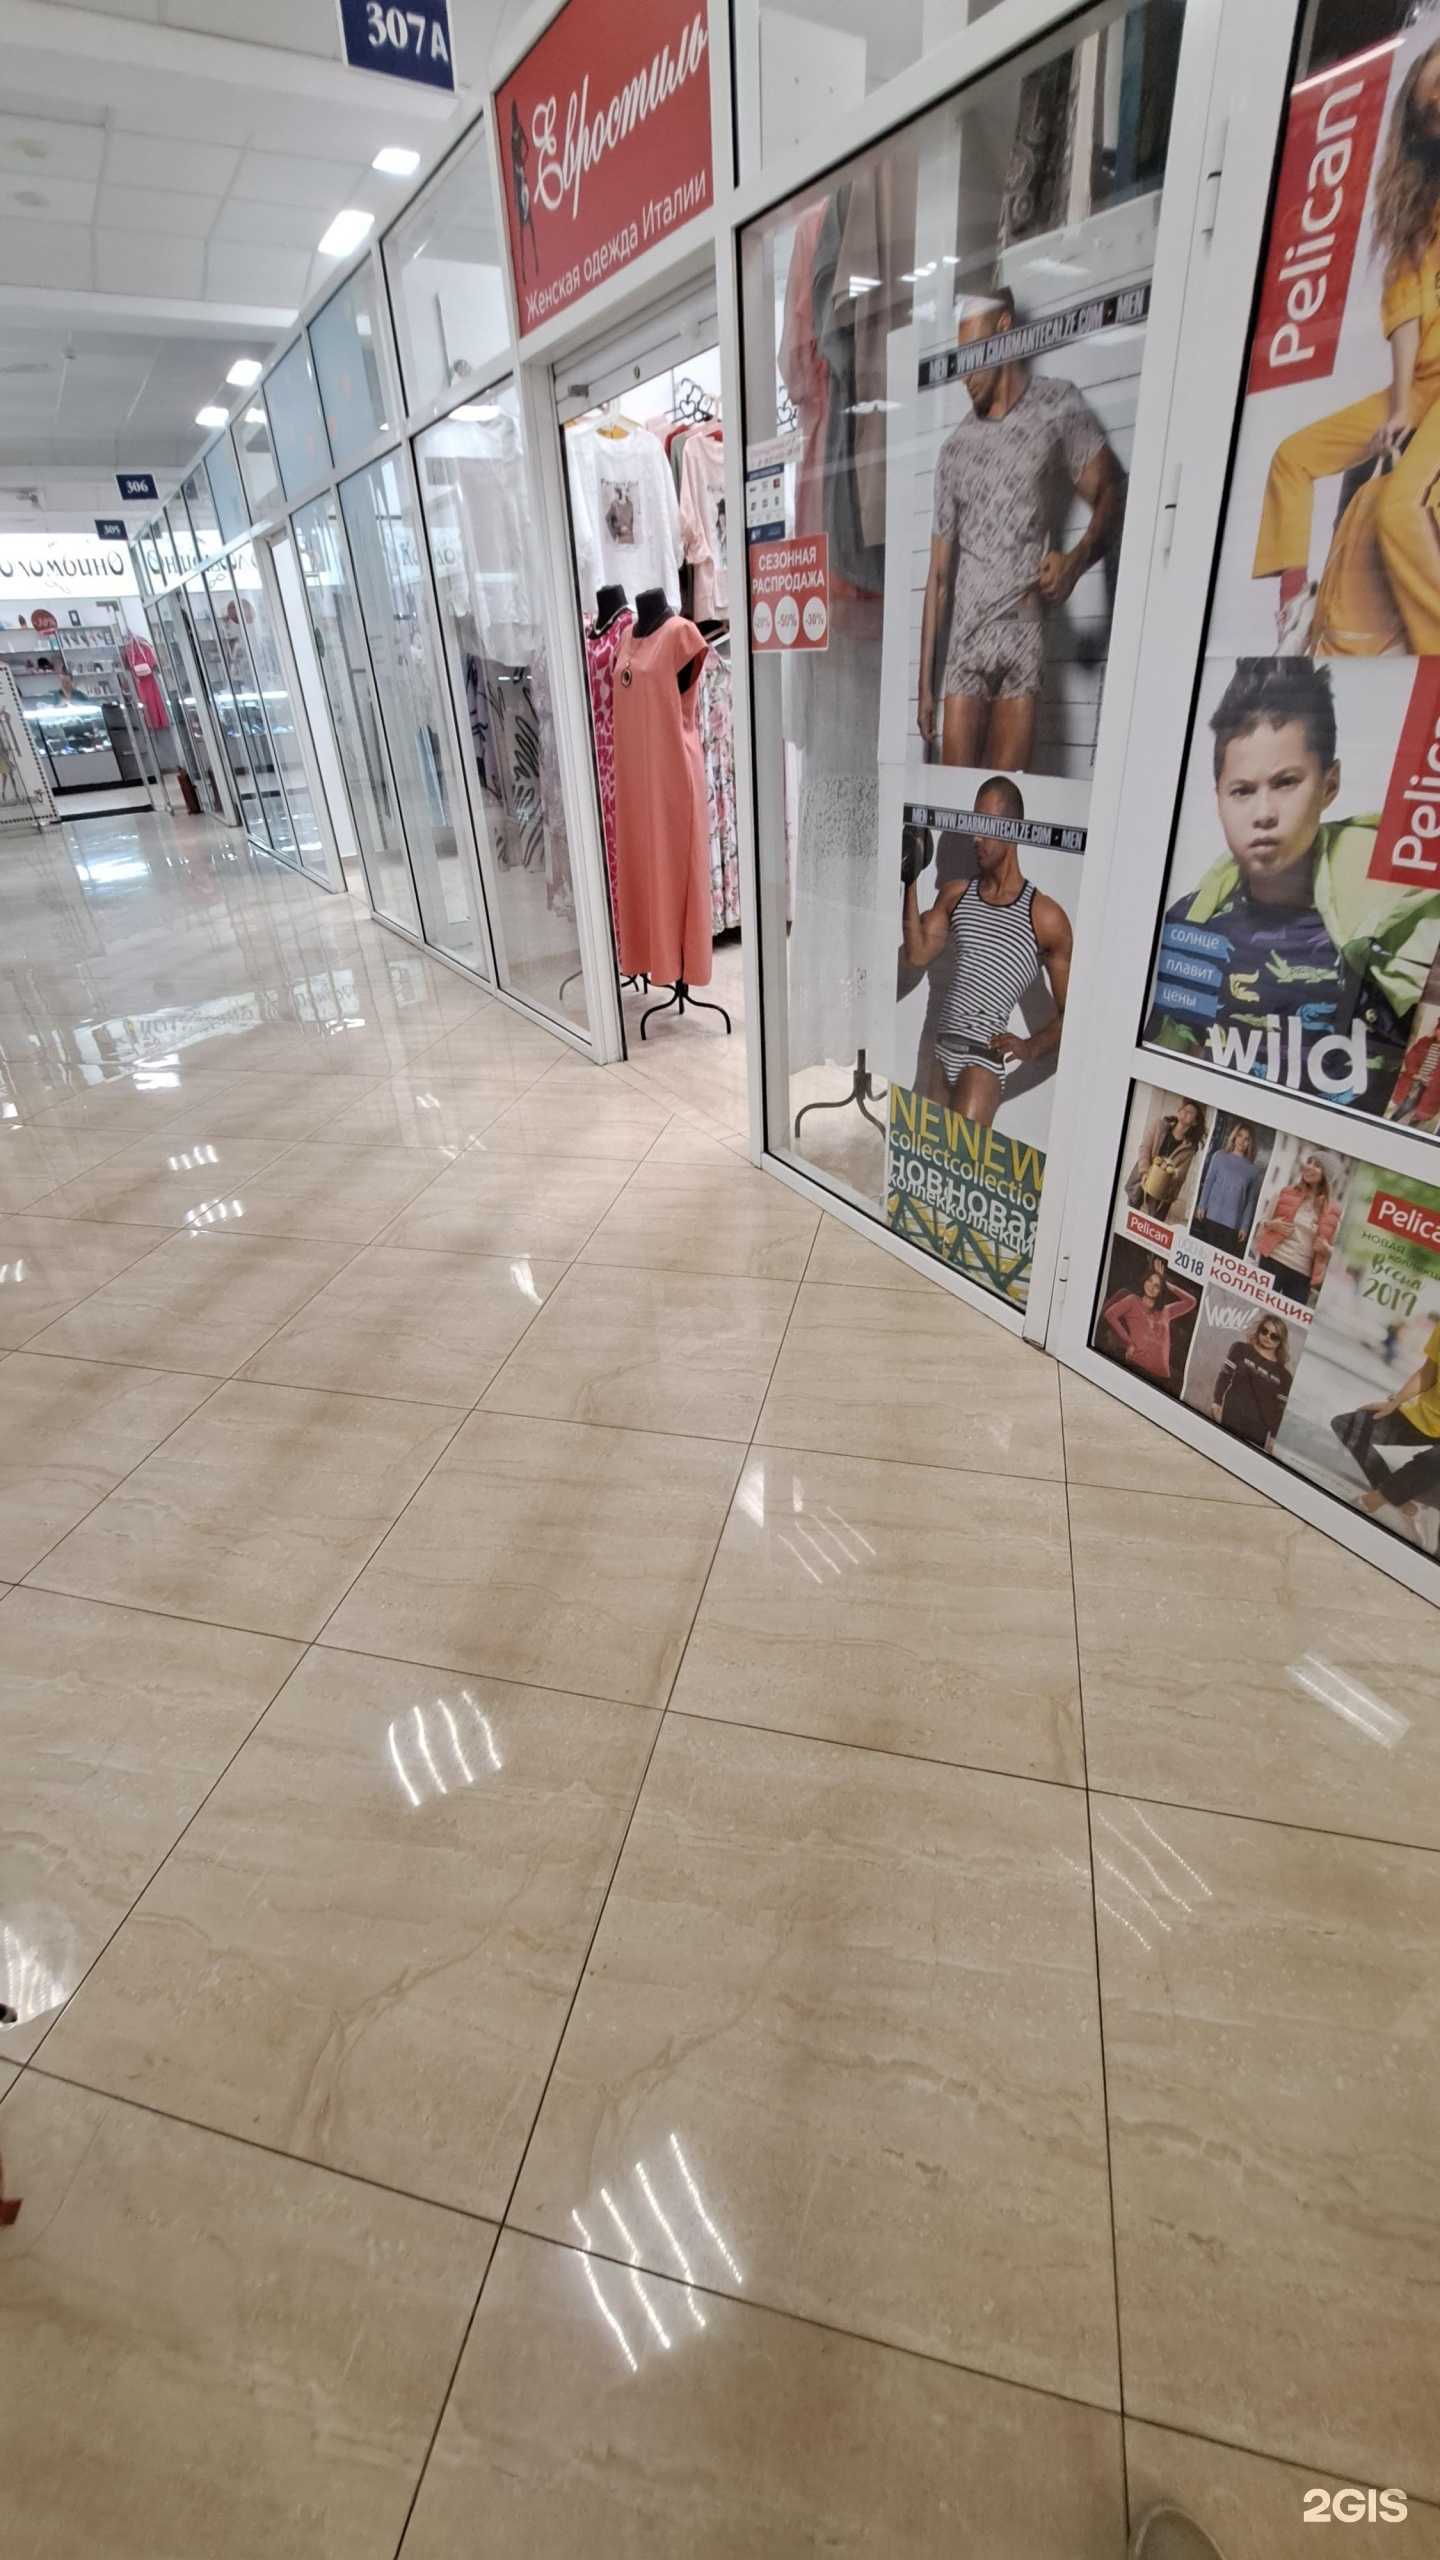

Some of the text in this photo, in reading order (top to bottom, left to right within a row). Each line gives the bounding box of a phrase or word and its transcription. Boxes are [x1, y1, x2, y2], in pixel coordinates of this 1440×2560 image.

[532, 11, 709, 220] Евростиль
[1270, 79, 1365, 368] Pelican
[525, 169, 706, 324] Женская одежда Италии
[928, 358, 948, 383] MEN
[1115, 287, 1146, 323] MEN
[126, 479, 149, 494] 306
[758, 546, 817, 571] СЕЗОННАЯ
[752, 569, 825, 595] РАСПРОДАЖА
[911, 807, 1083, 850] MEN WWW.CHARMANTECALZE.COM MEN
[1170, 927, 1220, 950] солнце
[1166, 958, 1213, 981] плавит
[1163, 988, 1197, 1008] цены
[1206, 1013, 1368, 1096] wild
[951, 1111, 1045, 1192] NEW
[1130, 1216, 1169, 1245] Pelican
[1175, 1251, 1205, 1277] 2018
[1212, 1252, 1272, 1288] НОВАЯ
[1209, 1265, 1315, 1326] КОЛЛЕКЦИЯ
